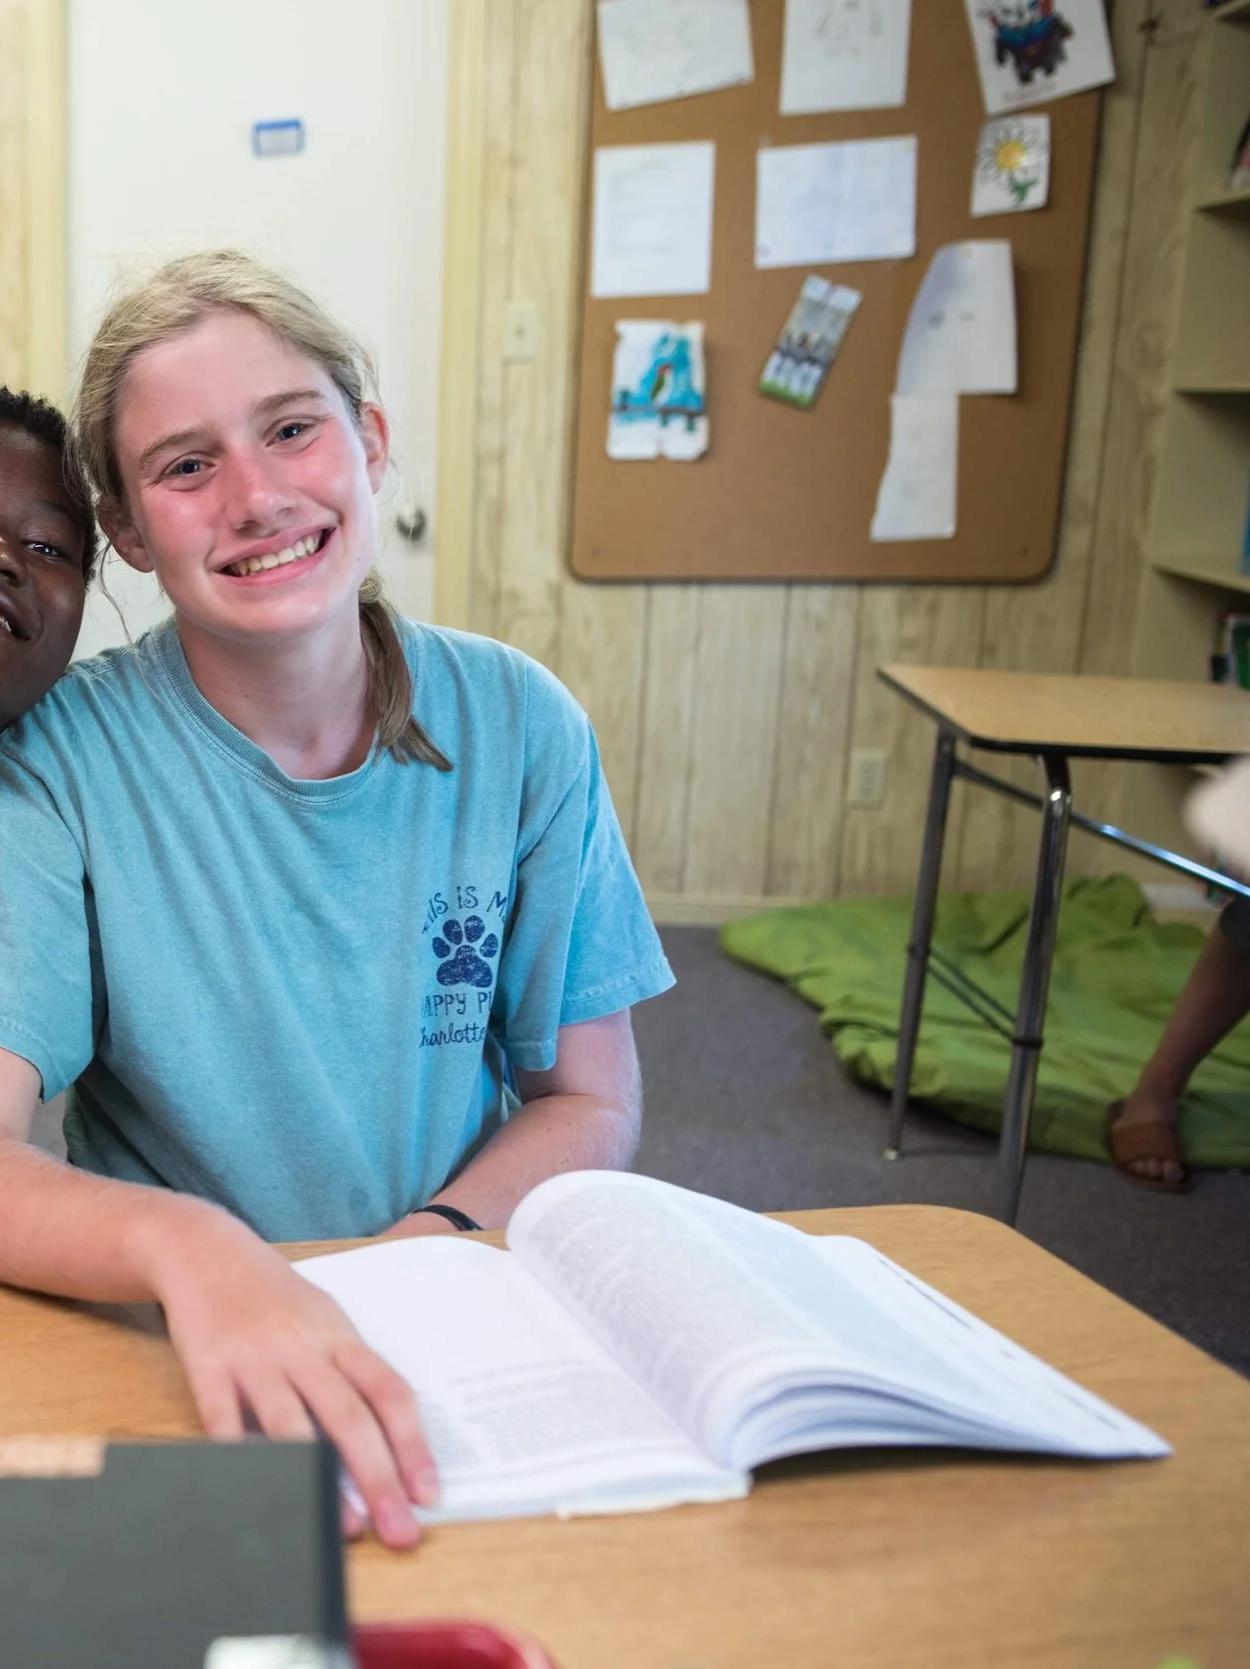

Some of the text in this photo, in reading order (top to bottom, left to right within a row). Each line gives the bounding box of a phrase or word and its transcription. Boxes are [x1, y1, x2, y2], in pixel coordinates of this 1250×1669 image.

[456, 885, 479, 910] IS
[486, 890, 508, 923] M
[421, 993, 467, 1018] APPY
[419, 1022, 487, 1049] harlotte
